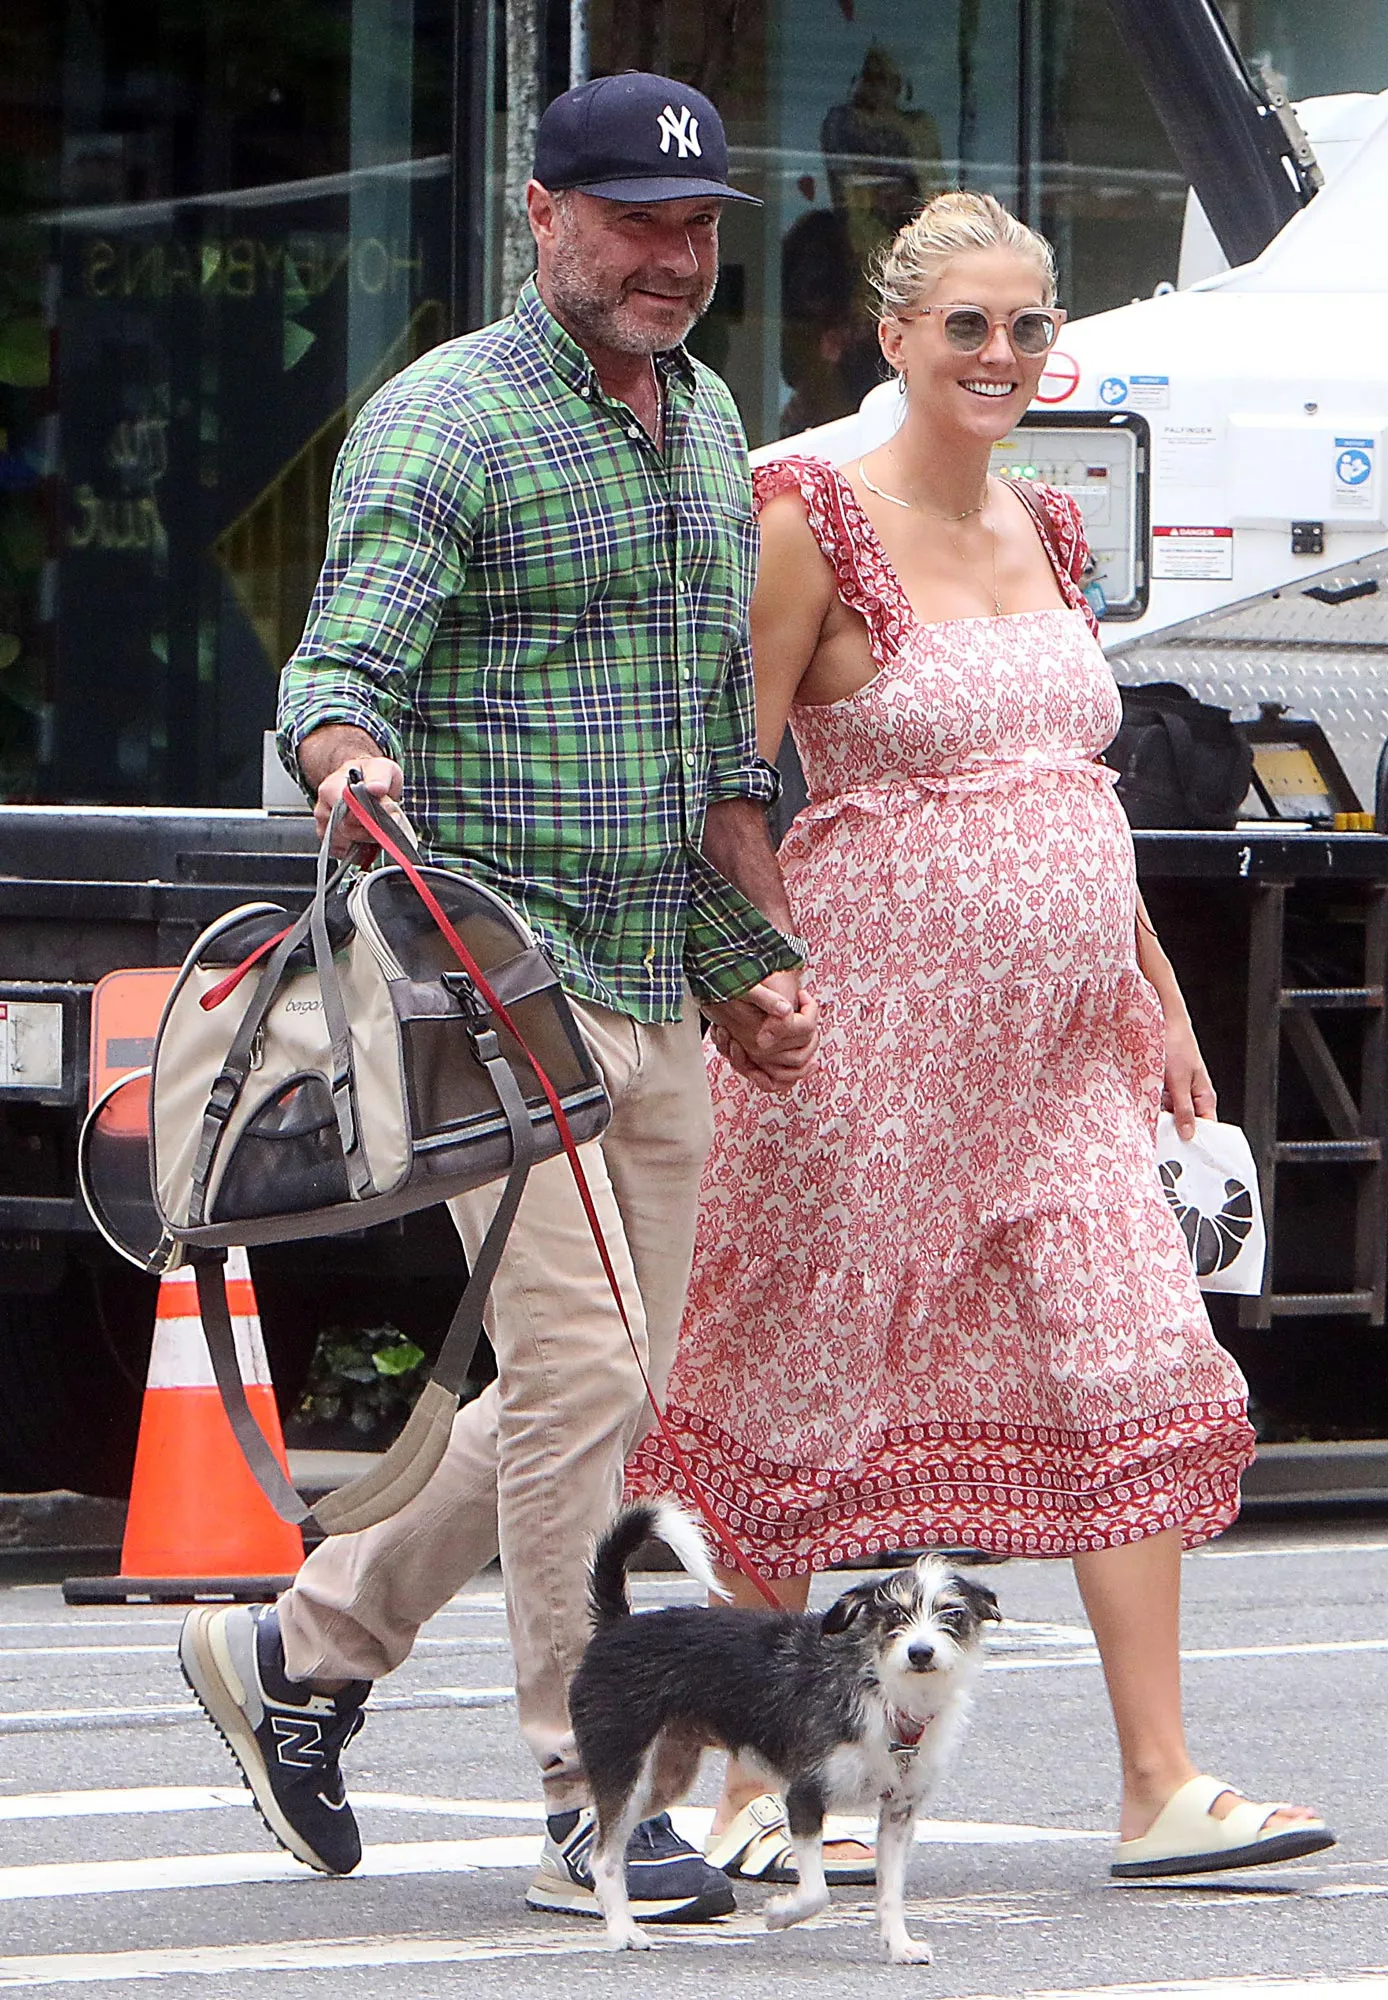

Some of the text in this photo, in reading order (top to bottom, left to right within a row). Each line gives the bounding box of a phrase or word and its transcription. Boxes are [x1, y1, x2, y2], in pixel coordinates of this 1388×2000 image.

[656, 105, 702, 158] NY
[1179, 528, 1215, 536] DANGER
[271, 1716, 327, 1768] N
